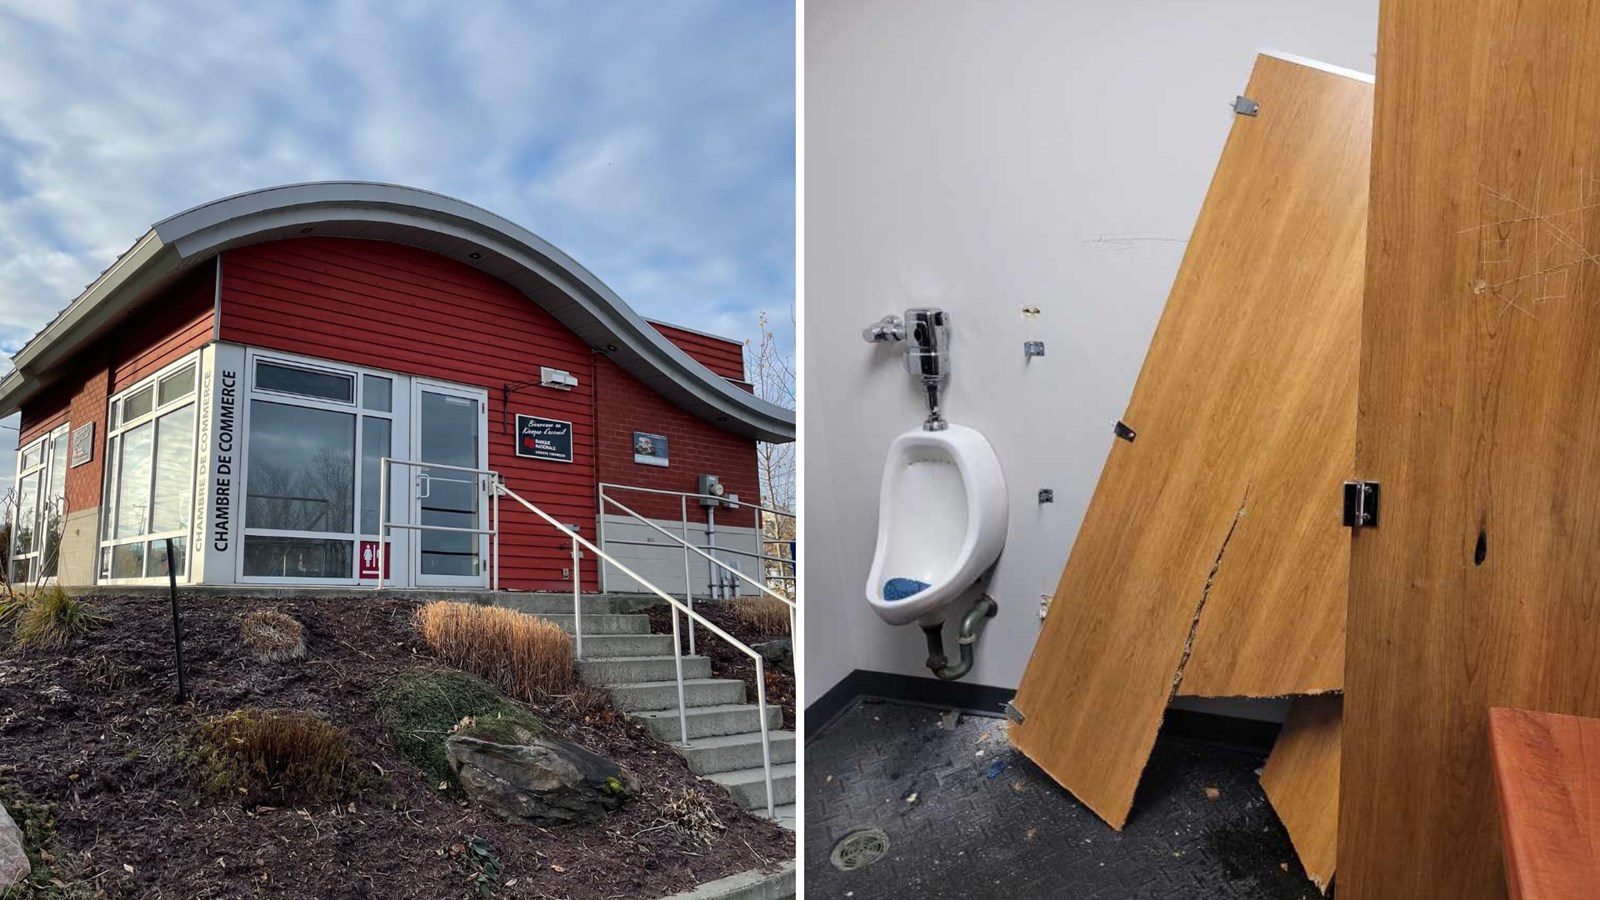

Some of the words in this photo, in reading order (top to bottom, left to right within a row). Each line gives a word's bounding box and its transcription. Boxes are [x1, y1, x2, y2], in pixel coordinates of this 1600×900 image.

[201, 369, 212, 453] COMMERCE
[218, 369, 236, 453] COMMERCE
[199, 455, 207, 475] DE
[217, 455, 232, 475] DE
[195, 478, 206, 552] CHAMBRE
[214, 478, 230, 552] CHAMBRE
